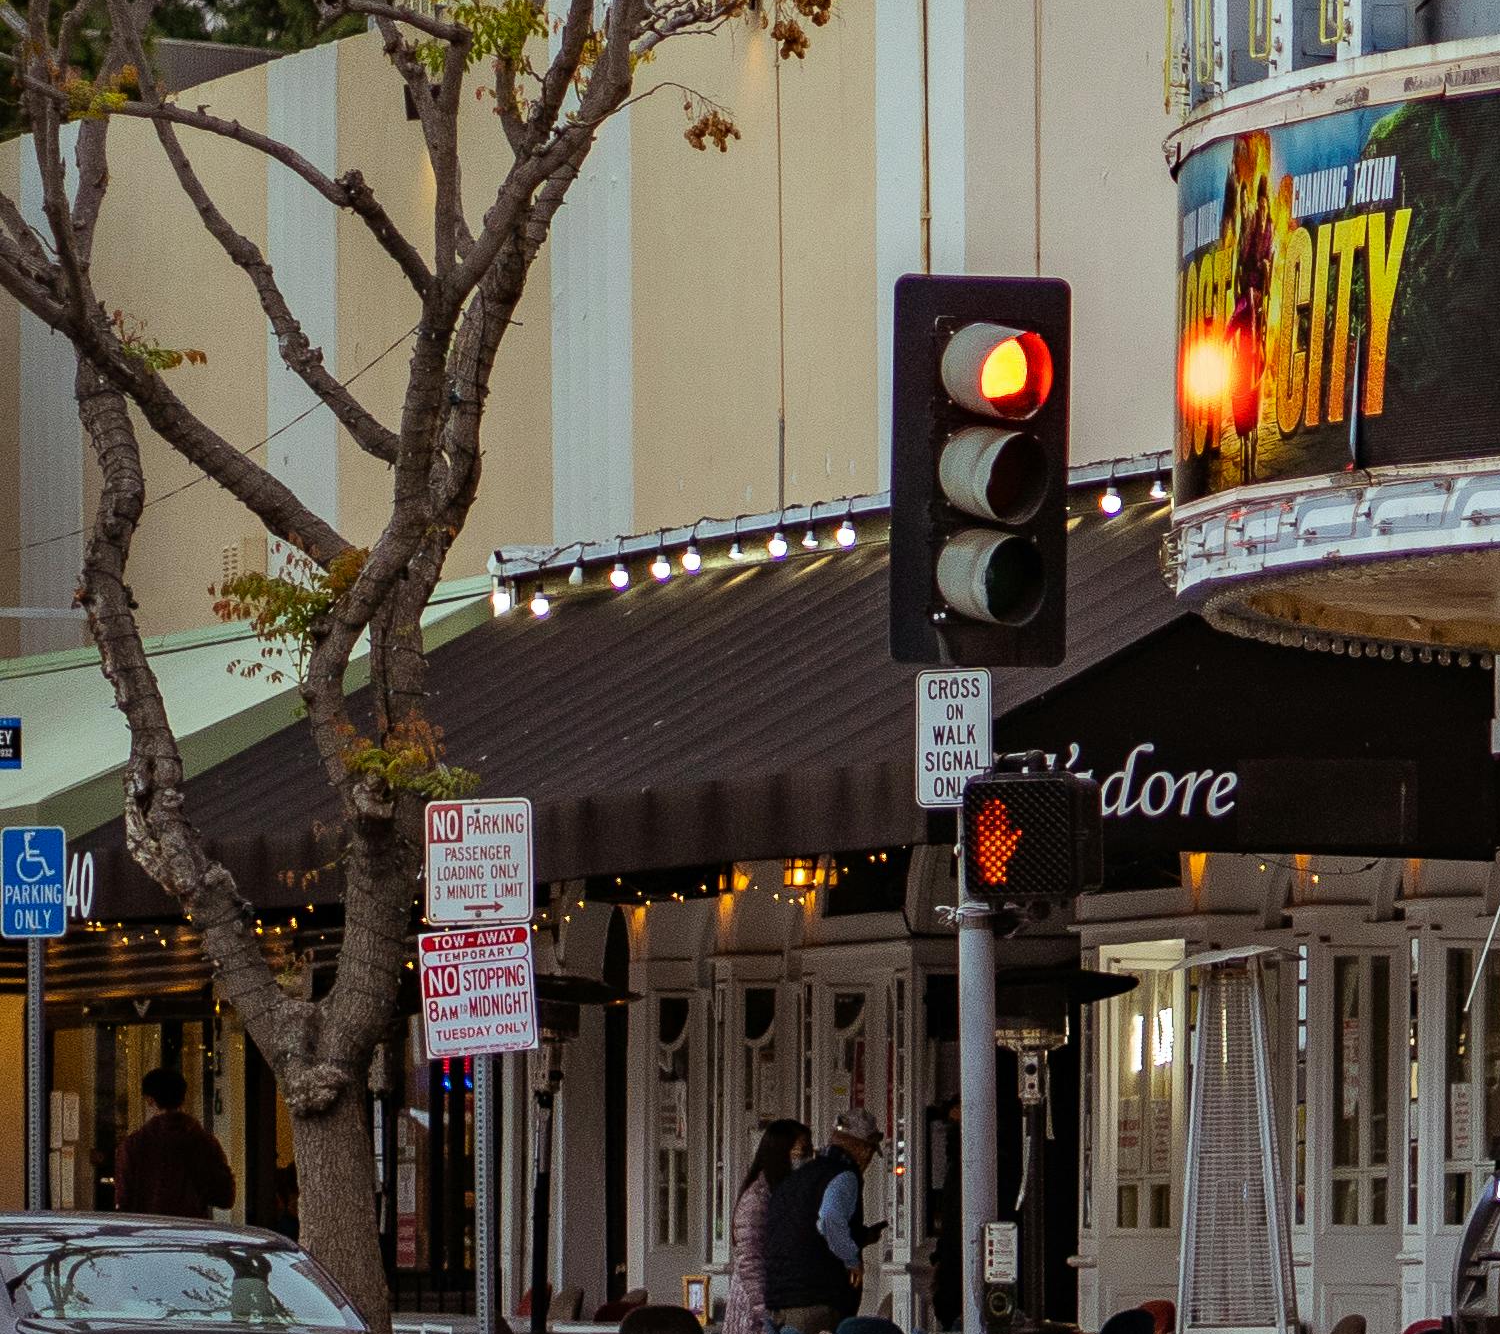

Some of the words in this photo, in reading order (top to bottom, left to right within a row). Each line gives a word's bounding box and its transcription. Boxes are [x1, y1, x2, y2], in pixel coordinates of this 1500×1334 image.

[1292, 165, 1348, 218] CHANNING
[1352, 155, 1396, 206] TATUM
[1276, 208, 1412, 433] CITY
[927, 677, 981, 700] CROSS
[946, 704, 964, 720] ON
[932, 723, 976, 745] WALK
[925, 750, 985, 772] SIGNAL
[433, 809, 459, 841] NO
[466, 813, 524, 835] PARKING
[445, 845, 511, 862] PASSENGER
[437, 864, 484, 881] LOADING
[490, 863, 520, 879] ONLY
[5, 883, 61, 905] PARKING
[434, 885, 442, 900] 3
[447, 883, 487, 900] MINUTE
[494, 882, 524, 898] LIMIT
[14, 909, 52, 930] ONLY
[432, 929, 516, 950] TOW-AWAY
[437, 946, 514, 963] TEMPORARY
[428, 967, 458, 996] NO
[463, 964, 525, 992] STOPPING
[429, 1001, 458, 1022] 8AM
[469, 991, 528, 1018] MIDNIGHT
[436, 1025, 491, 1042] TUESDAY
[495, 1021, 528, 1034] ONLY
